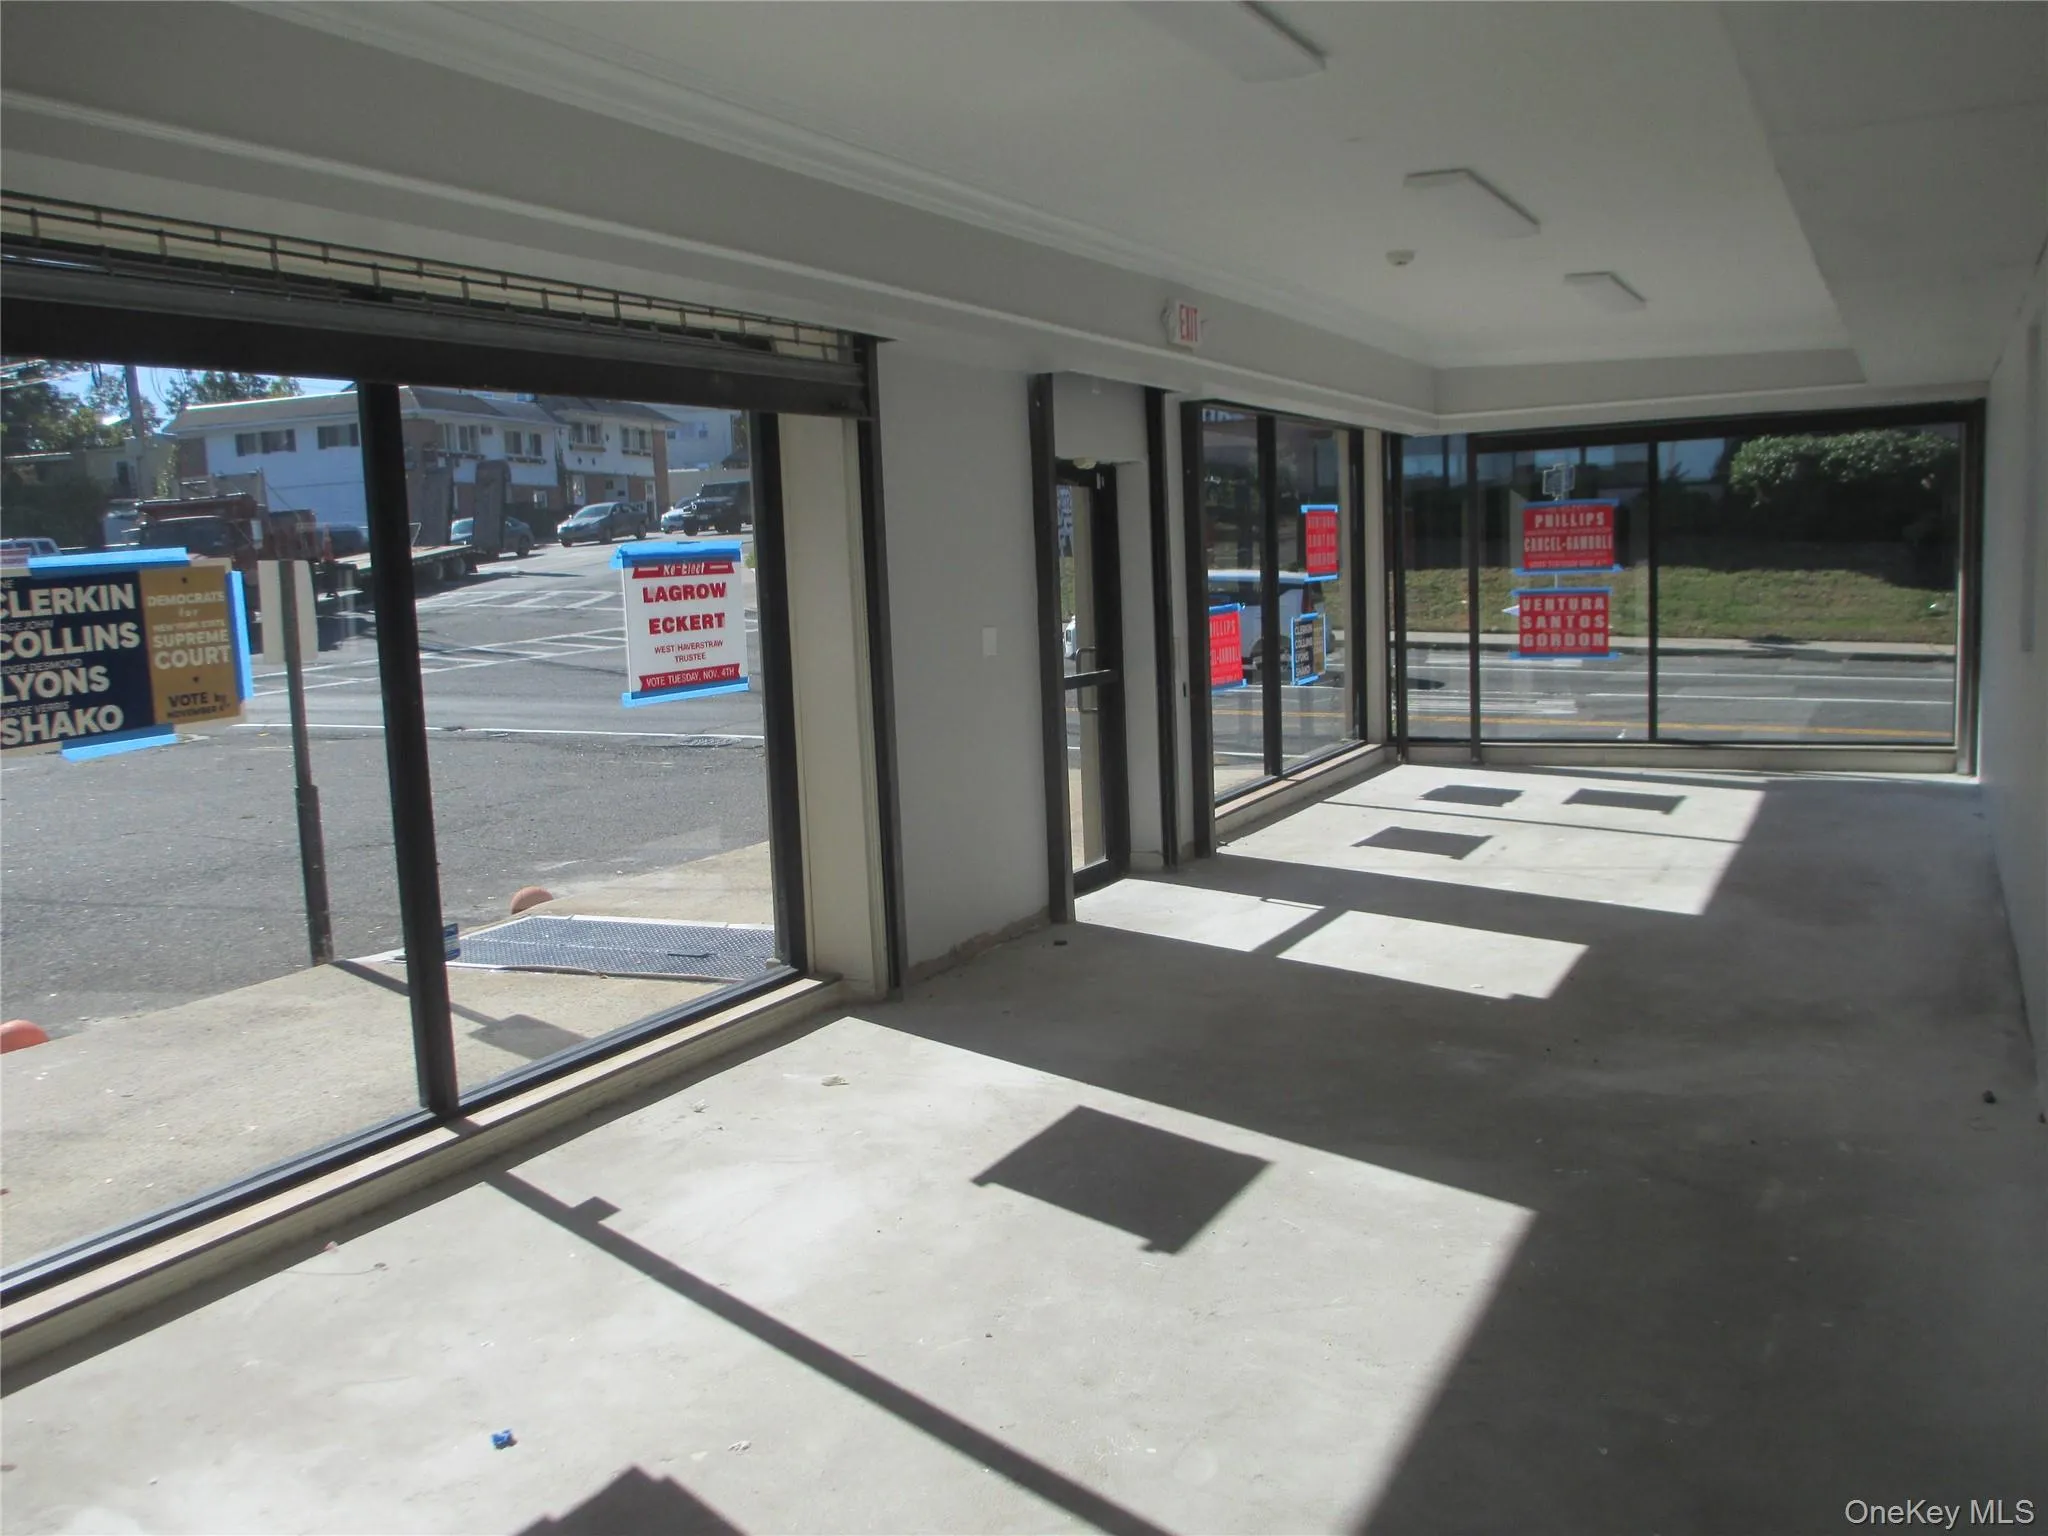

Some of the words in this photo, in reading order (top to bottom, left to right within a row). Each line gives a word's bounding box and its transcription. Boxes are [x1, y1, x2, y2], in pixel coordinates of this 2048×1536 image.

[1179, 303, 1198, 342] EXIT
[1534, 511, 1605, 528] PHILLIPS
[147, 590, 225, 607] DEMOCRATS
[642, 582, 727, 604] LAGROW
[1521, 597, 1605, 612] VENTURA
[648, 612, 725, 635] ECKERT
[1521, 614, 1605, 629] SANTOS
[152, 629, 229, 648] SUPREME
[654, 645, 675, 654] WEST
[677, 639, 724, 652] HAVERSTRAW
[1522, 632, 1605, 648] GORDON
[154, 645, 232, 670] COURT
[674, 652, 706, 663] TRUSTEE
[0, 665, 110, 704] LYONS
[646, 676, 666, 688] VOTE
[721, 667, 735, 677] 4TH
[168, 691, 208, 708] VOTE
[0, 704, 125, 745] SHAKO
